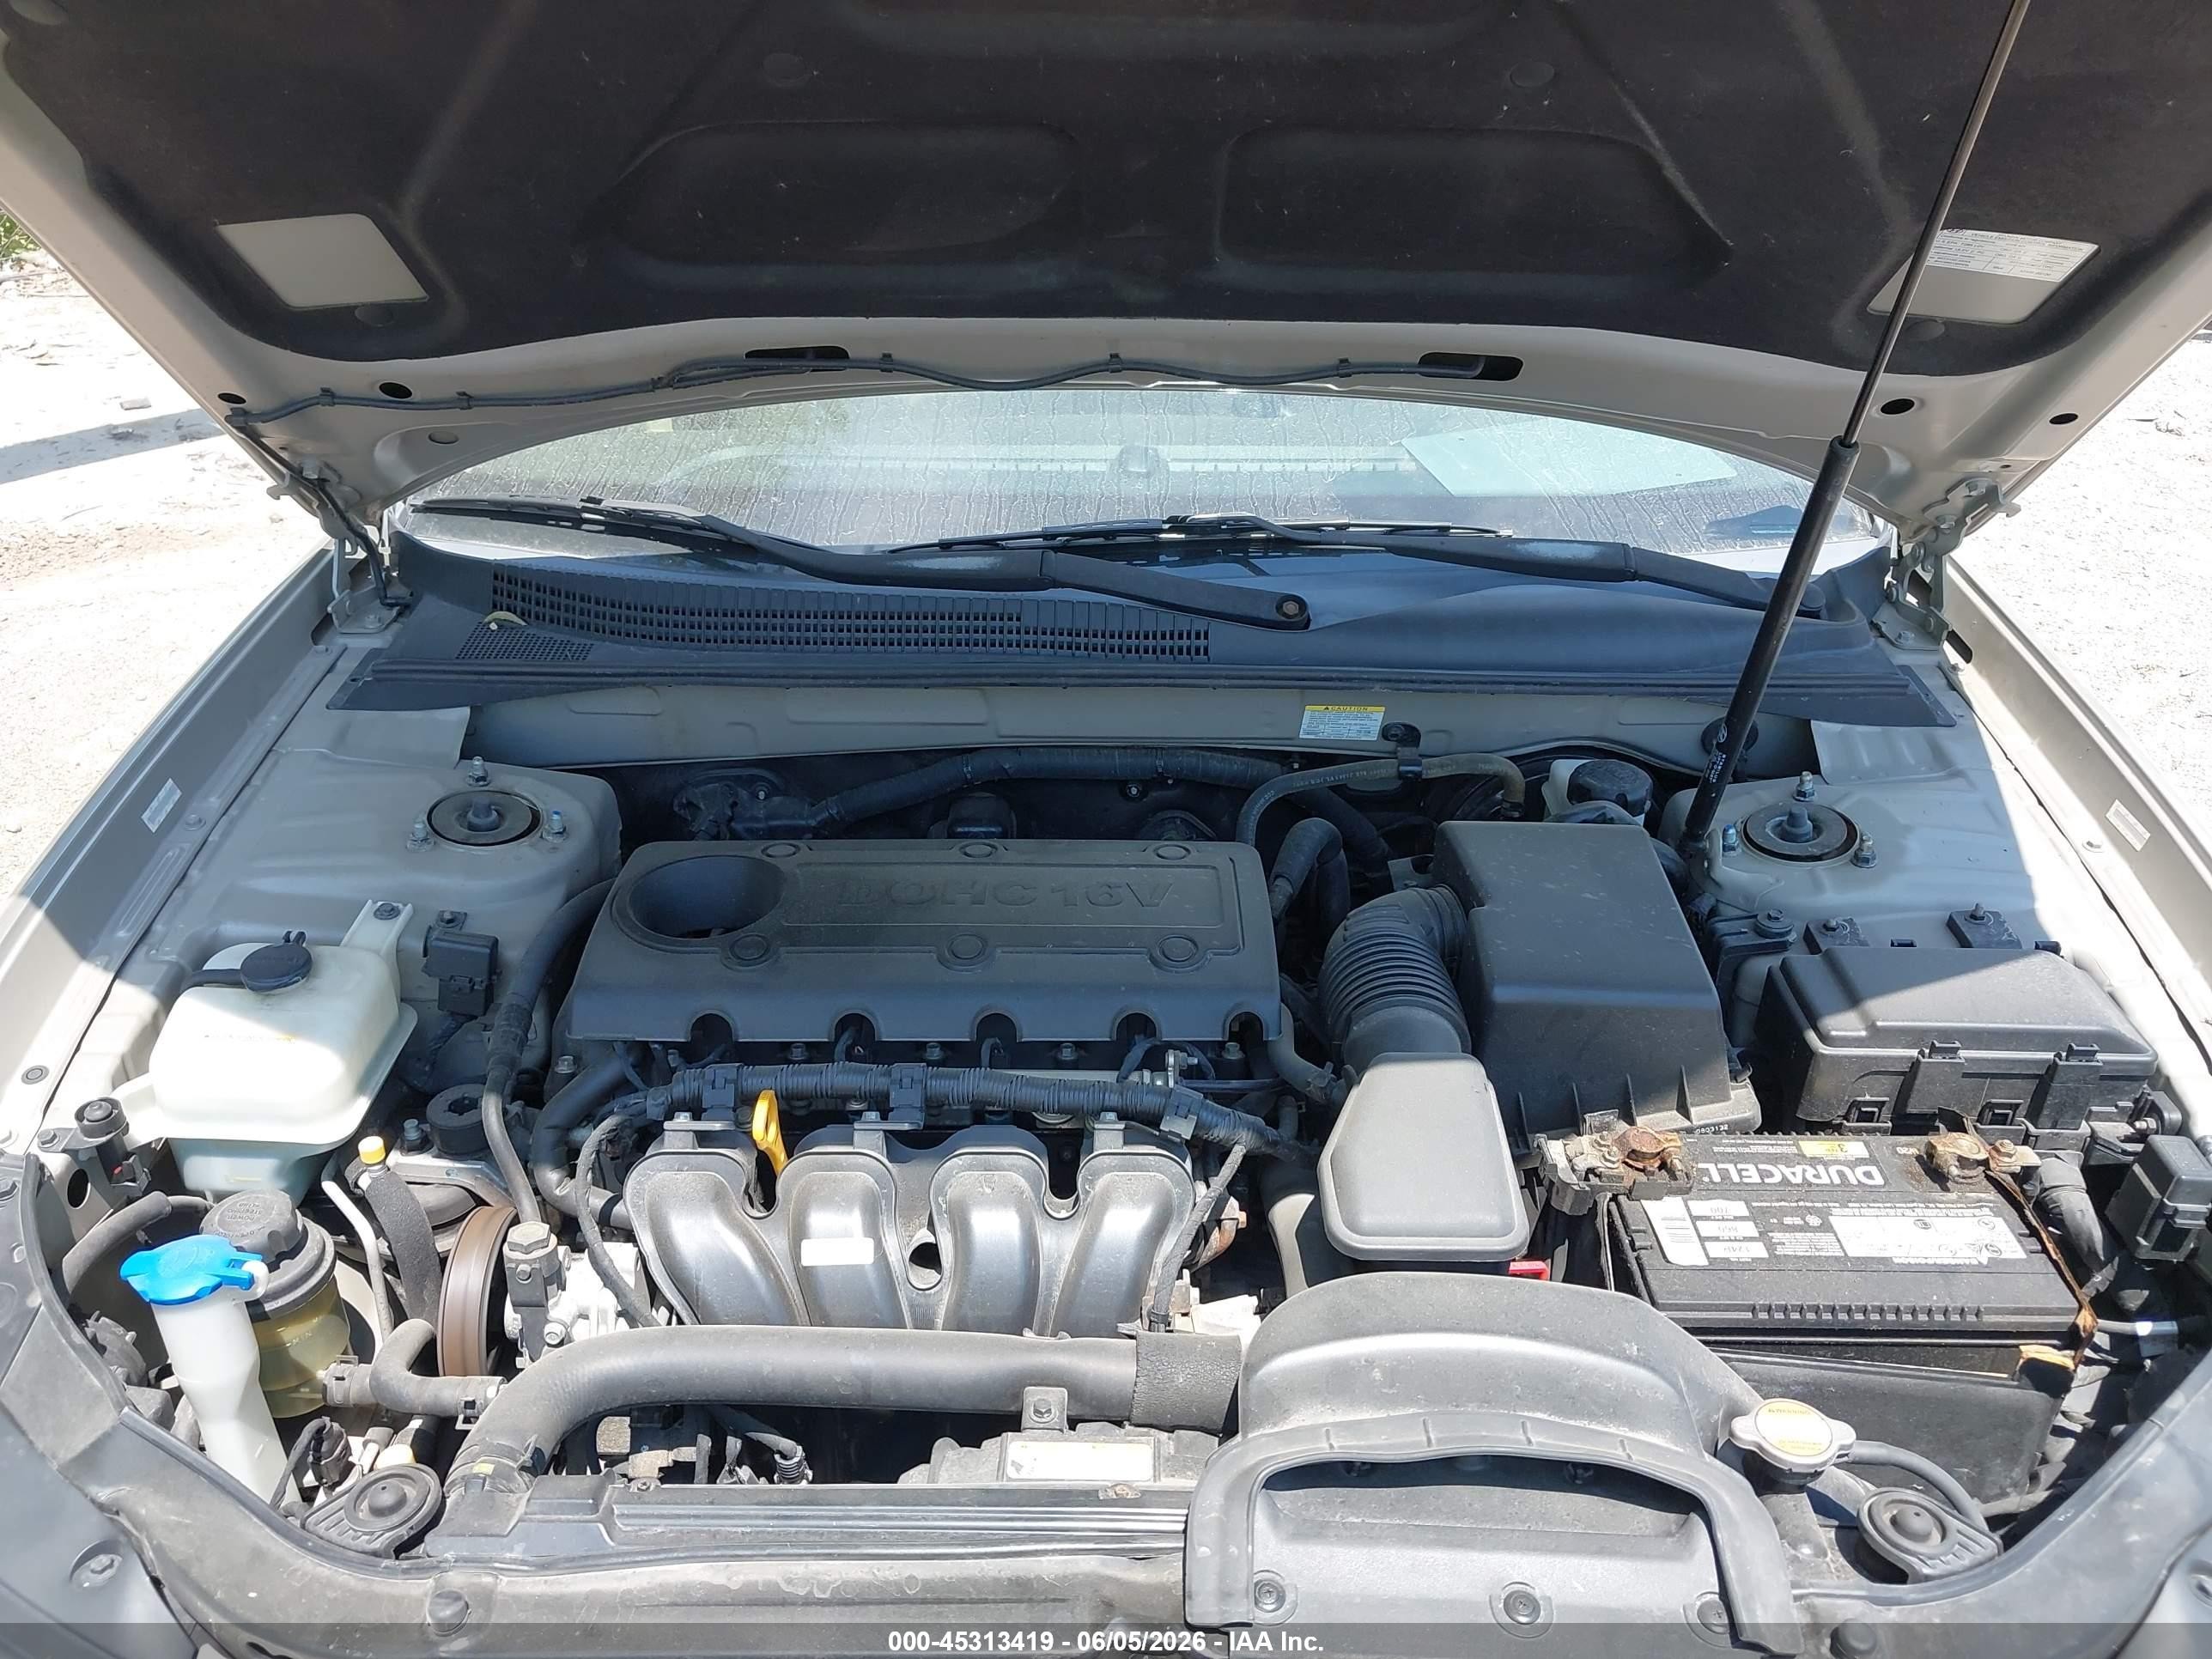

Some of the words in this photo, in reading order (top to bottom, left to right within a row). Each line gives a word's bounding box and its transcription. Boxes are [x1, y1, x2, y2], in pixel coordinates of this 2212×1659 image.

[1711, 753, 1727, 783] STABILUS
[839, 878, 1038, 907] DOHC
[1050, 881, 1175, 908] 16V
[1838, 1143, 1848, 1153] 3
[1698, 1163, 1885, 1186] DURACELL
